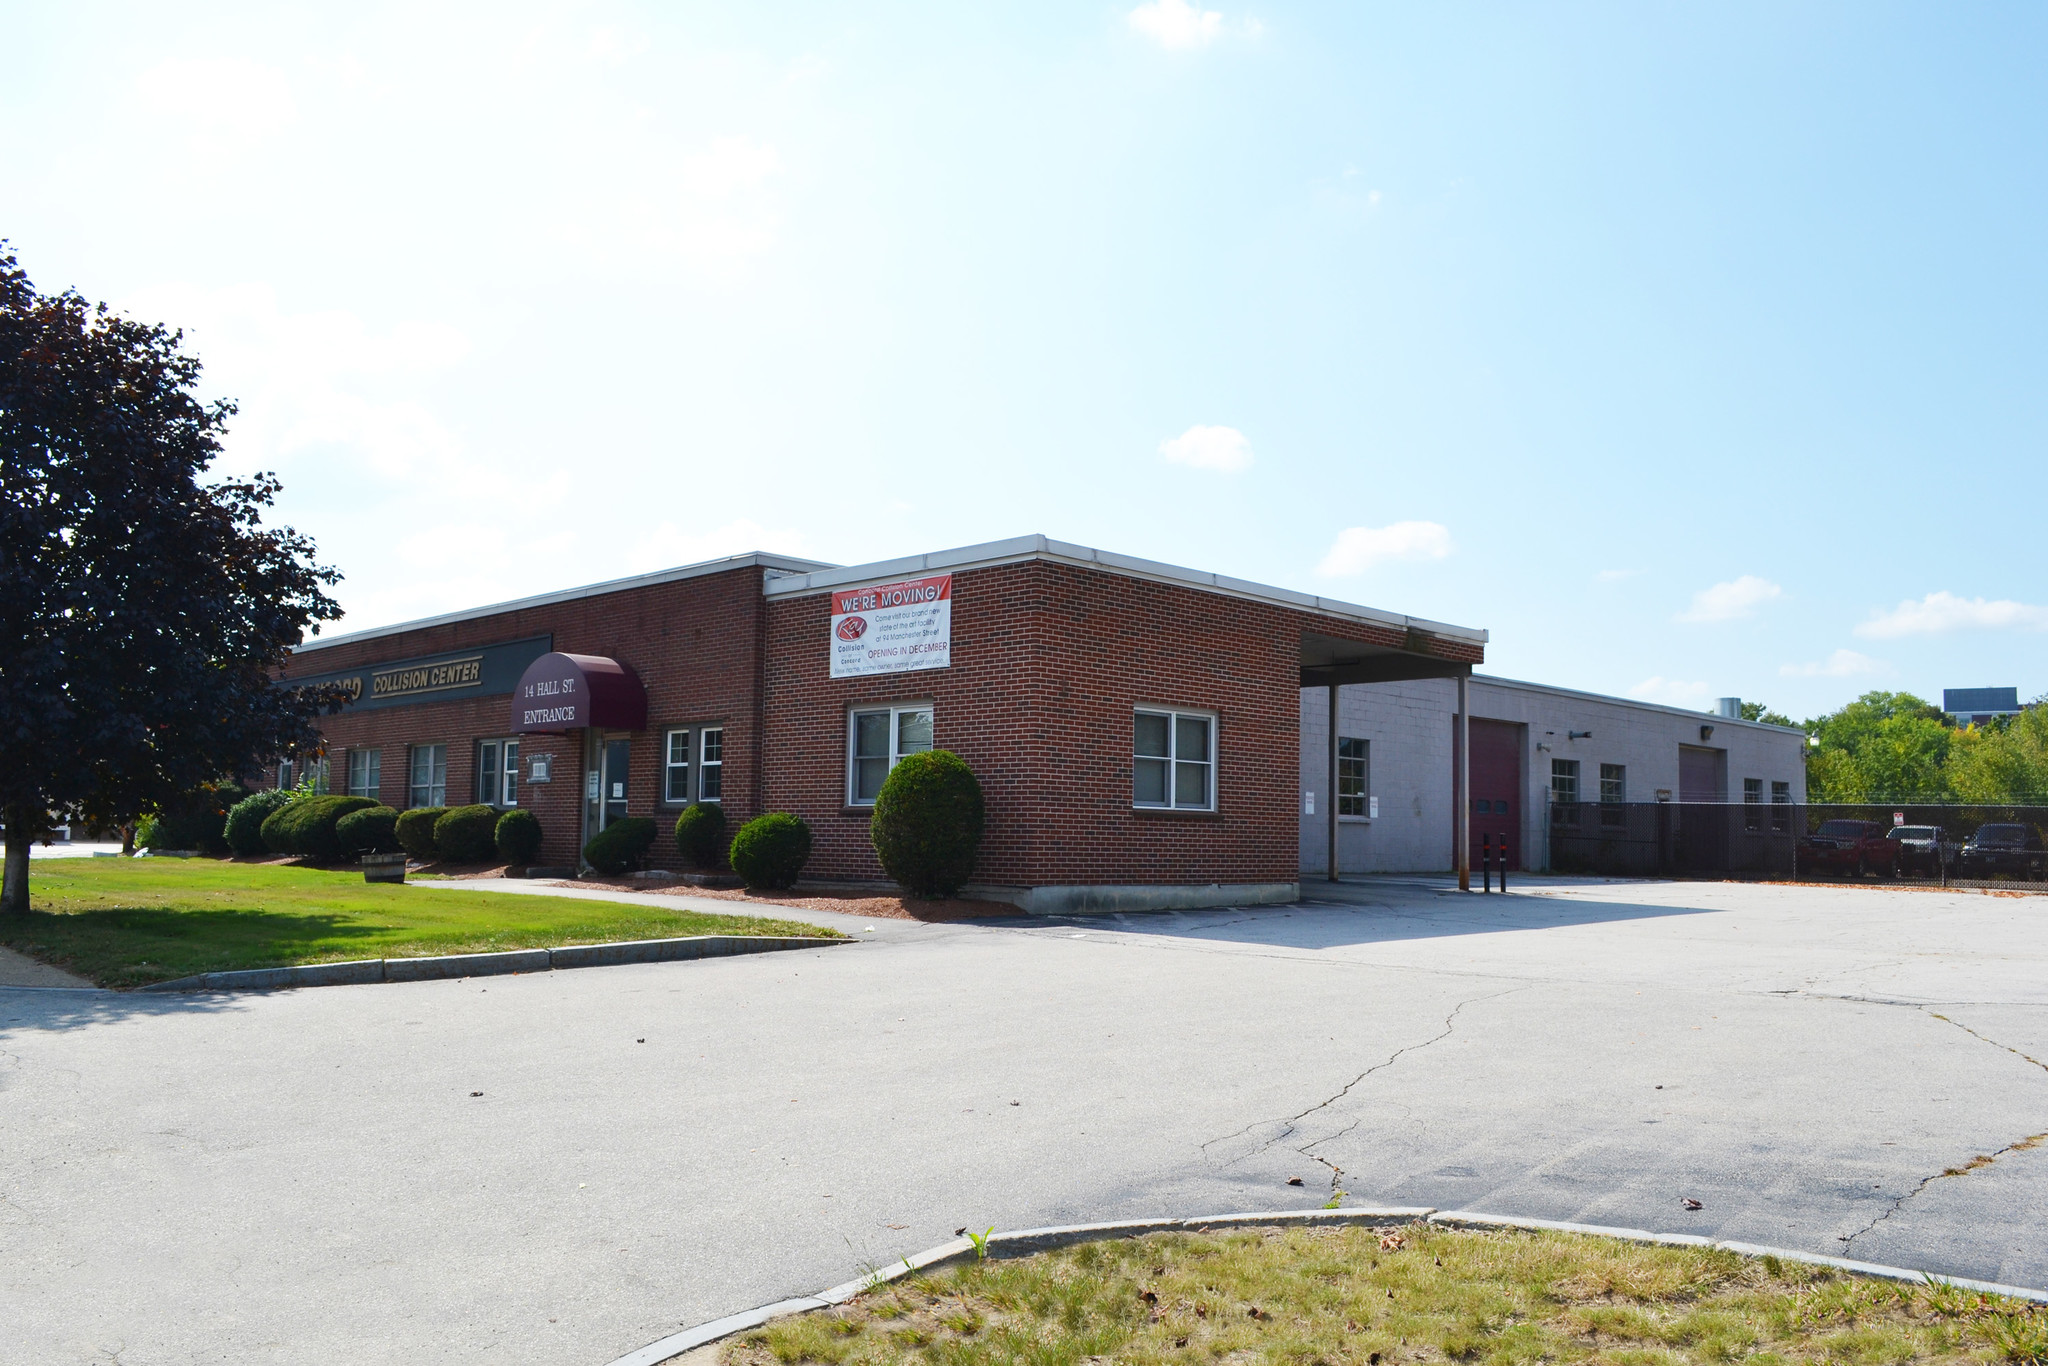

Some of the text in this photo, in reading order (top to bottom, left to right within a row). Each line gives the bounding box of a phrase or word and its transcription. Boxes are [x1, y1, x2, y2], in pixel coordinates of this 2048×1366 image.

[858, 580, 923, 596] Concord Collision Center
[841, 585, 940, 612] WE'RE MOVING!
[892, 612, 902, 620] visit
[911, 608, 928, 618] brand
[879, 624, 892, 632] state
[892, 622, 898, 630] of
[917, 618, 936, 627] facility
[890, 630, 922, 640] Manchester
[922, 628, 940, 637] Street
[838, 644, 865, 653] Collision
[868, 642, 948, 659] OPENING IN DECEMBER
[910, 660, 924, 668] great
[373, 669, 429, 692] COLLISION
[431, 662, 480, 685] CENTER
[524, 678, 576, 698] 14 HALL ST.
[524, 706, 575, 724] ENTRANCE
